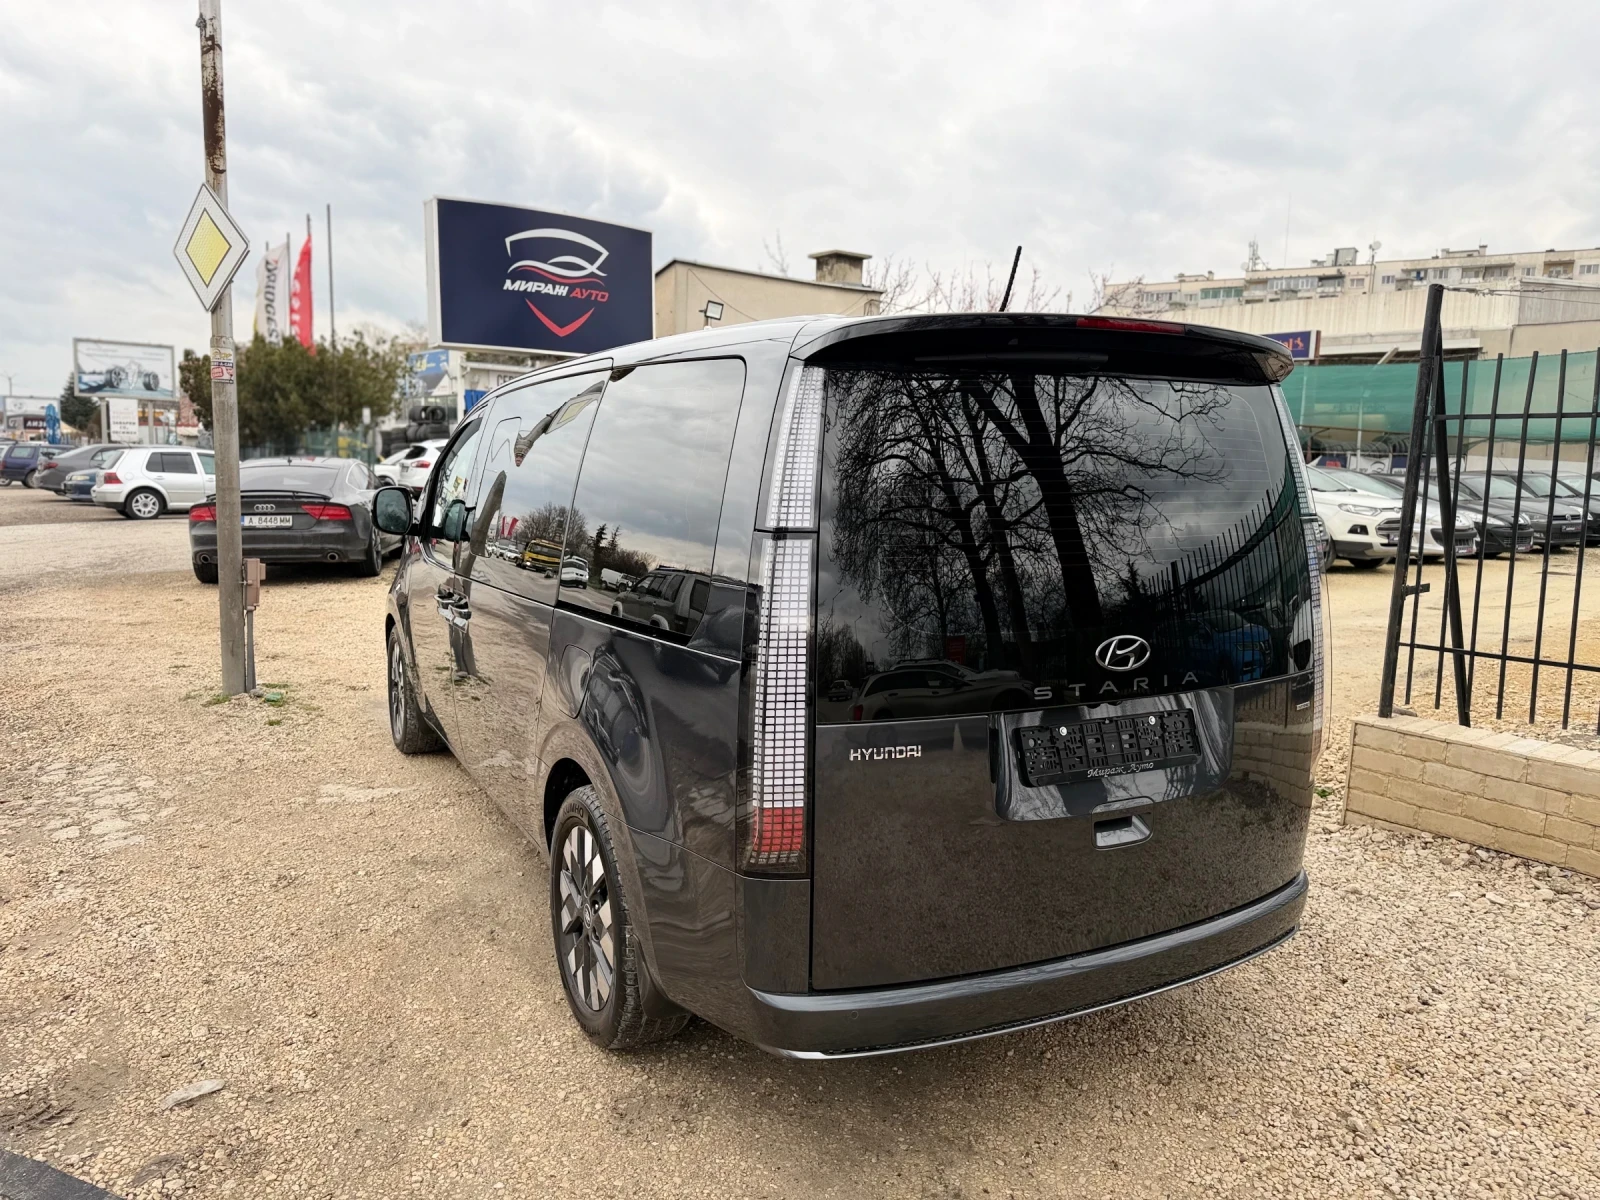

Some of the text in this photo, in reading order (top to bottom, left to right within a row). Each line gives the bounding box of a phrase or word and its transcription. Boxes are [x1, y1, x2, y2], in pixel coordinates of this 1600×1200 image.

[503, 279, 609, 303] МИРАЖ АУТО
[258, 516, 278, 525] 8448
[1033, 671, 1199, 700] STARIA
[848, 745, 922, 761] HYUNDAI
